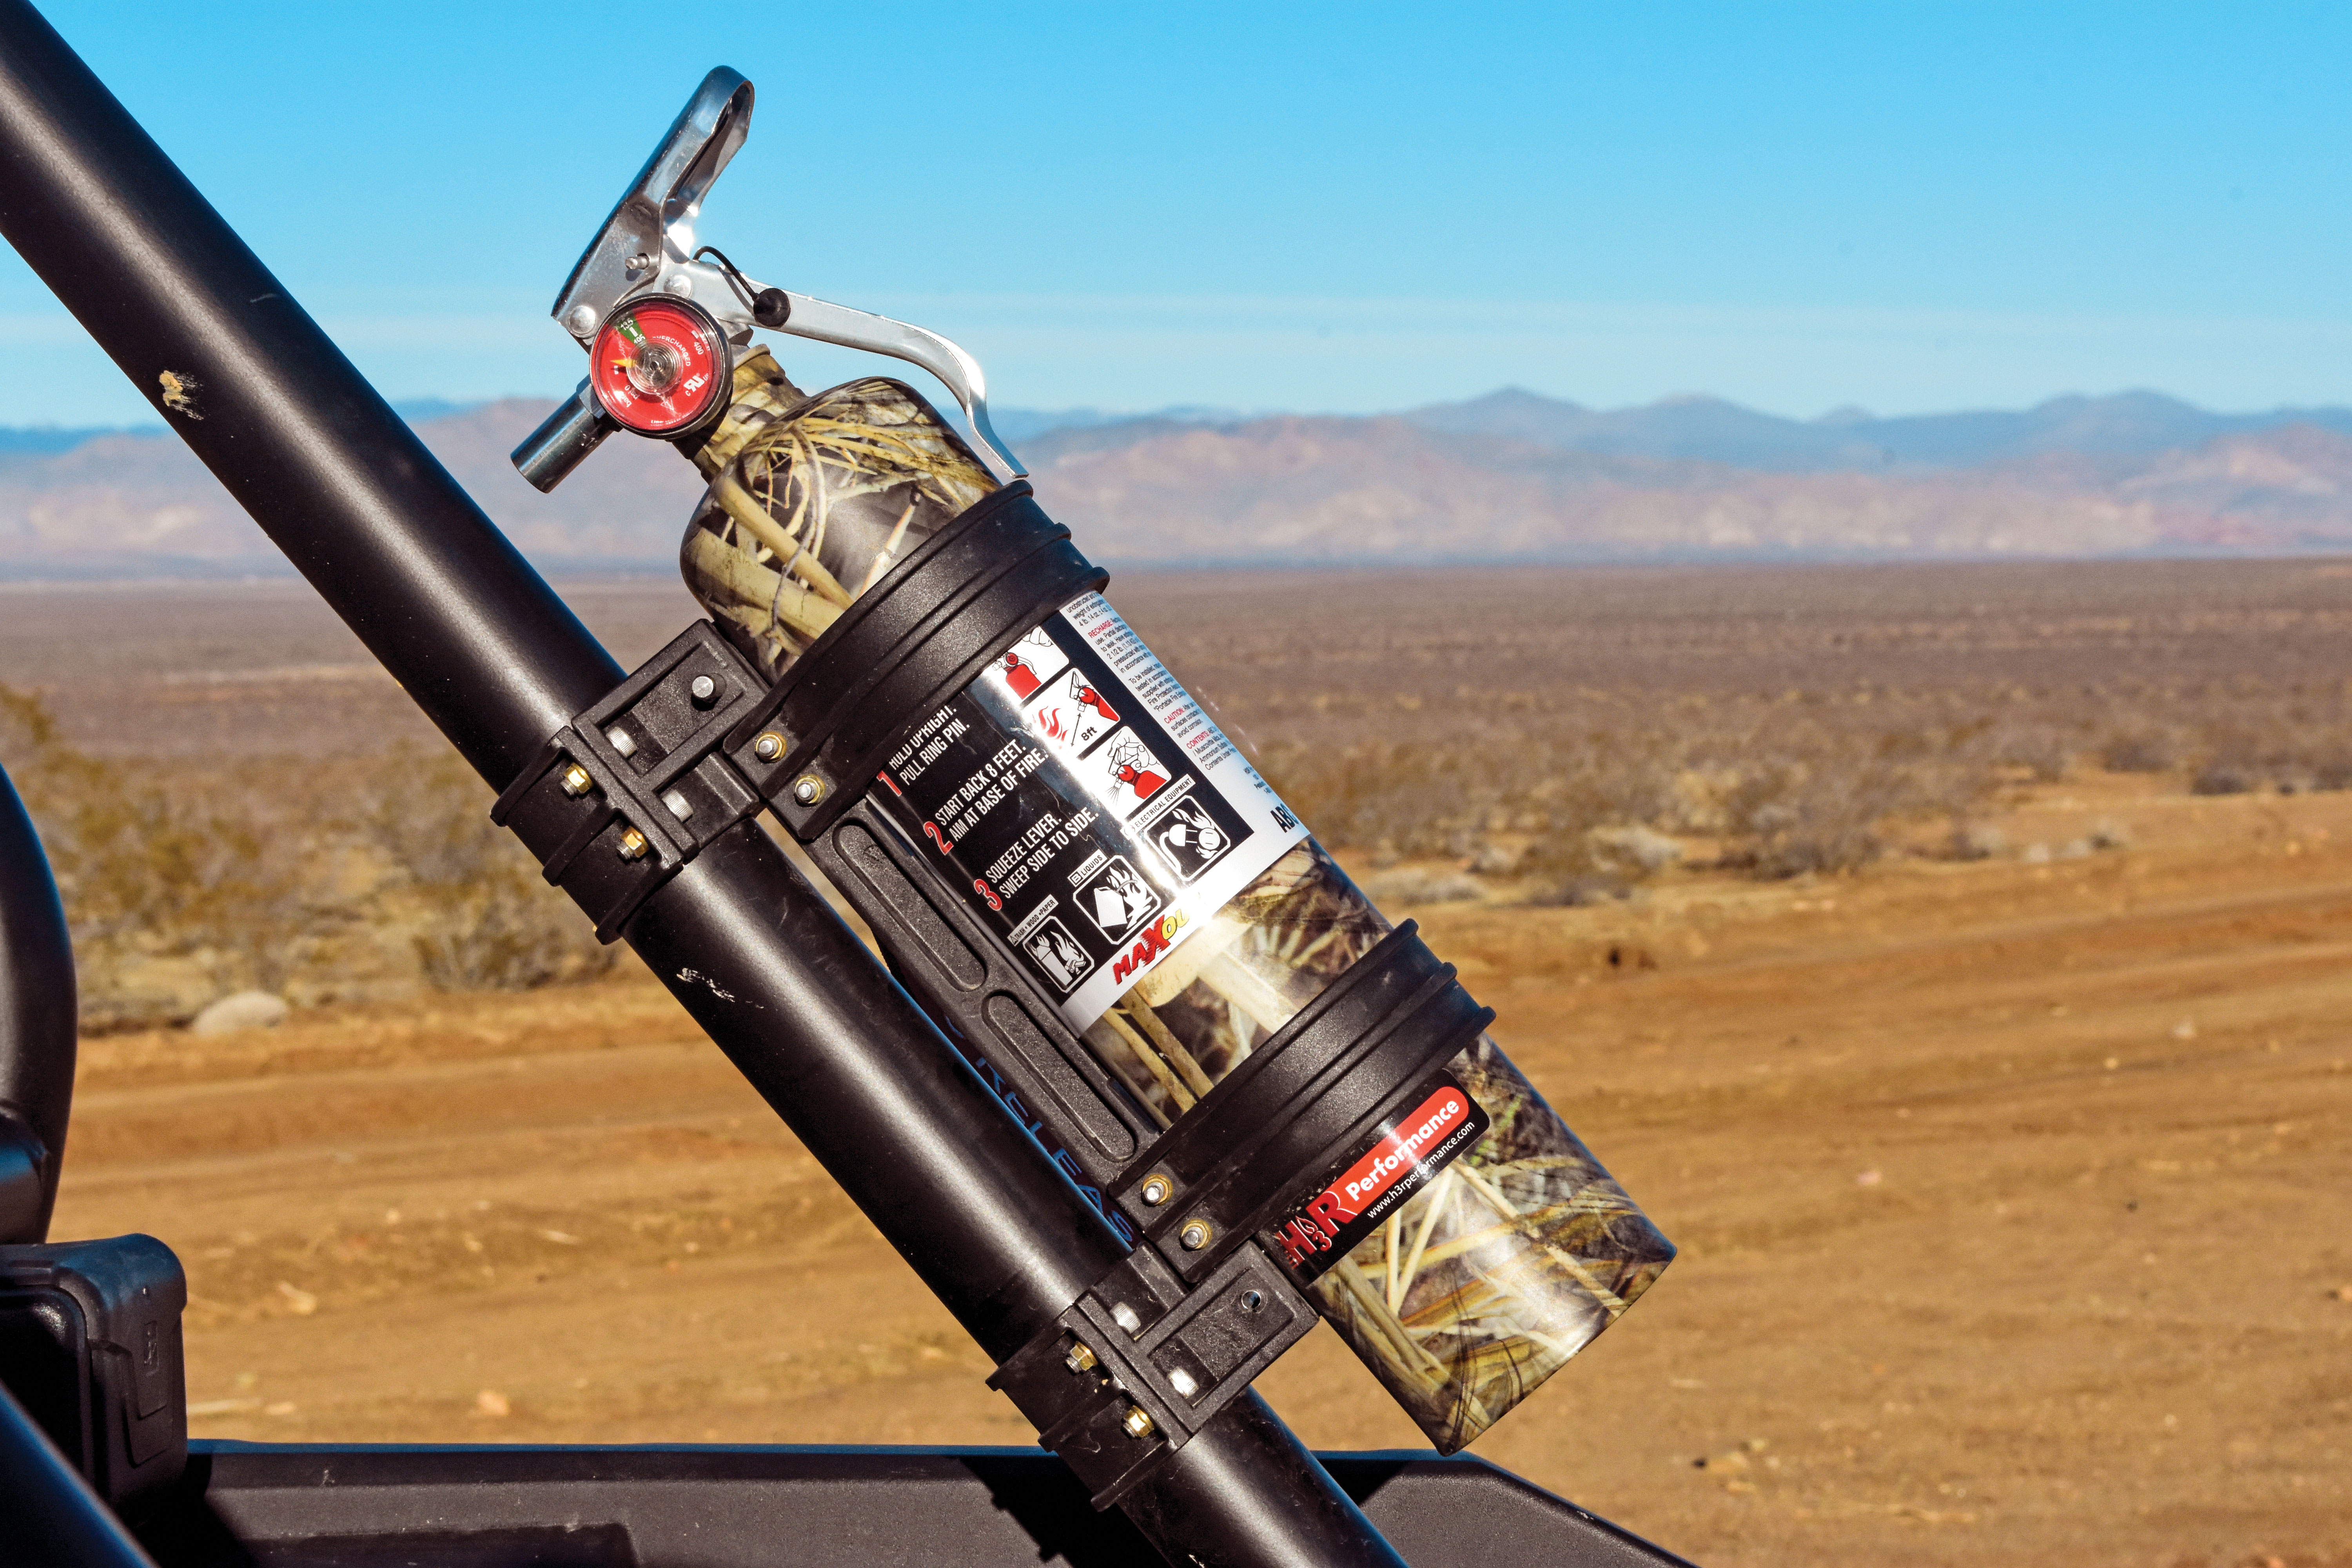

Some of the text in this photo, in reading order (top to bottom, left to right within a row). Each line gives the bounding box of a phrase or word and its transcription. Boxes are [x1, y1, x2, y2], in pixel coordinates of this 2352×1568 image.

[652, 336, 691, 366] VERCHARGED
[694, 342, 704, 355] 400
[1073, 608, 1087, 620] weight
[1105, 640, 1117, 649] leak.
[1113, 649, 1135, 668] pressurized
[1125, 655, 1144, 670] accordance
[1135, 679, 1149, 691] tested
[1142, 684, 1160, 699] supplied
[1147, 697, 1158, 706] Fire
[1156, 687, 1173, 700] Protection
[1082, 727, 1097, 740] 8ft
[1171, 717, 1188, 731] surfaces
[1177, 726, 1189, 738] avoid
[900, 718, 969, 785] PULL RING PIN.
[1194, 739, 1215, 754] Muscovite
[1199, 747, 1220, 764] Ammonium
[1205, 756, 1223, 770] Contents
[877, 771, 902, 797] 1
[935, 739, 1026, 825] START BACK 8 FEET.
[949, 748, 1049, 841] AIM AT BASE OF FIRE.
[1134, 778, 1191, 829] ELECTRICAL EQUIPMENT
[923, 821, 953, 855] 2
[986, 813, 1062, 883] SQUEEZE LEVER.
[1000, 807, 1099, 898] SWEEP SIDE TO SIDE.
[1080, 855, 1102, 876] LIQUIDS
[974, 879, 1002, 911] 3
[1014, 927, 1026, 940] TRASH
[1026, 914, 1039, 927] WOOD
[1113, 908, 1190, 984] MAXOU
[975, 1057, 1135, 1242] RELEAS
[1345, 1099, 1460, 1201] Performance
[1367, 1120, 1475, 1219] www.h3rperformance.com
